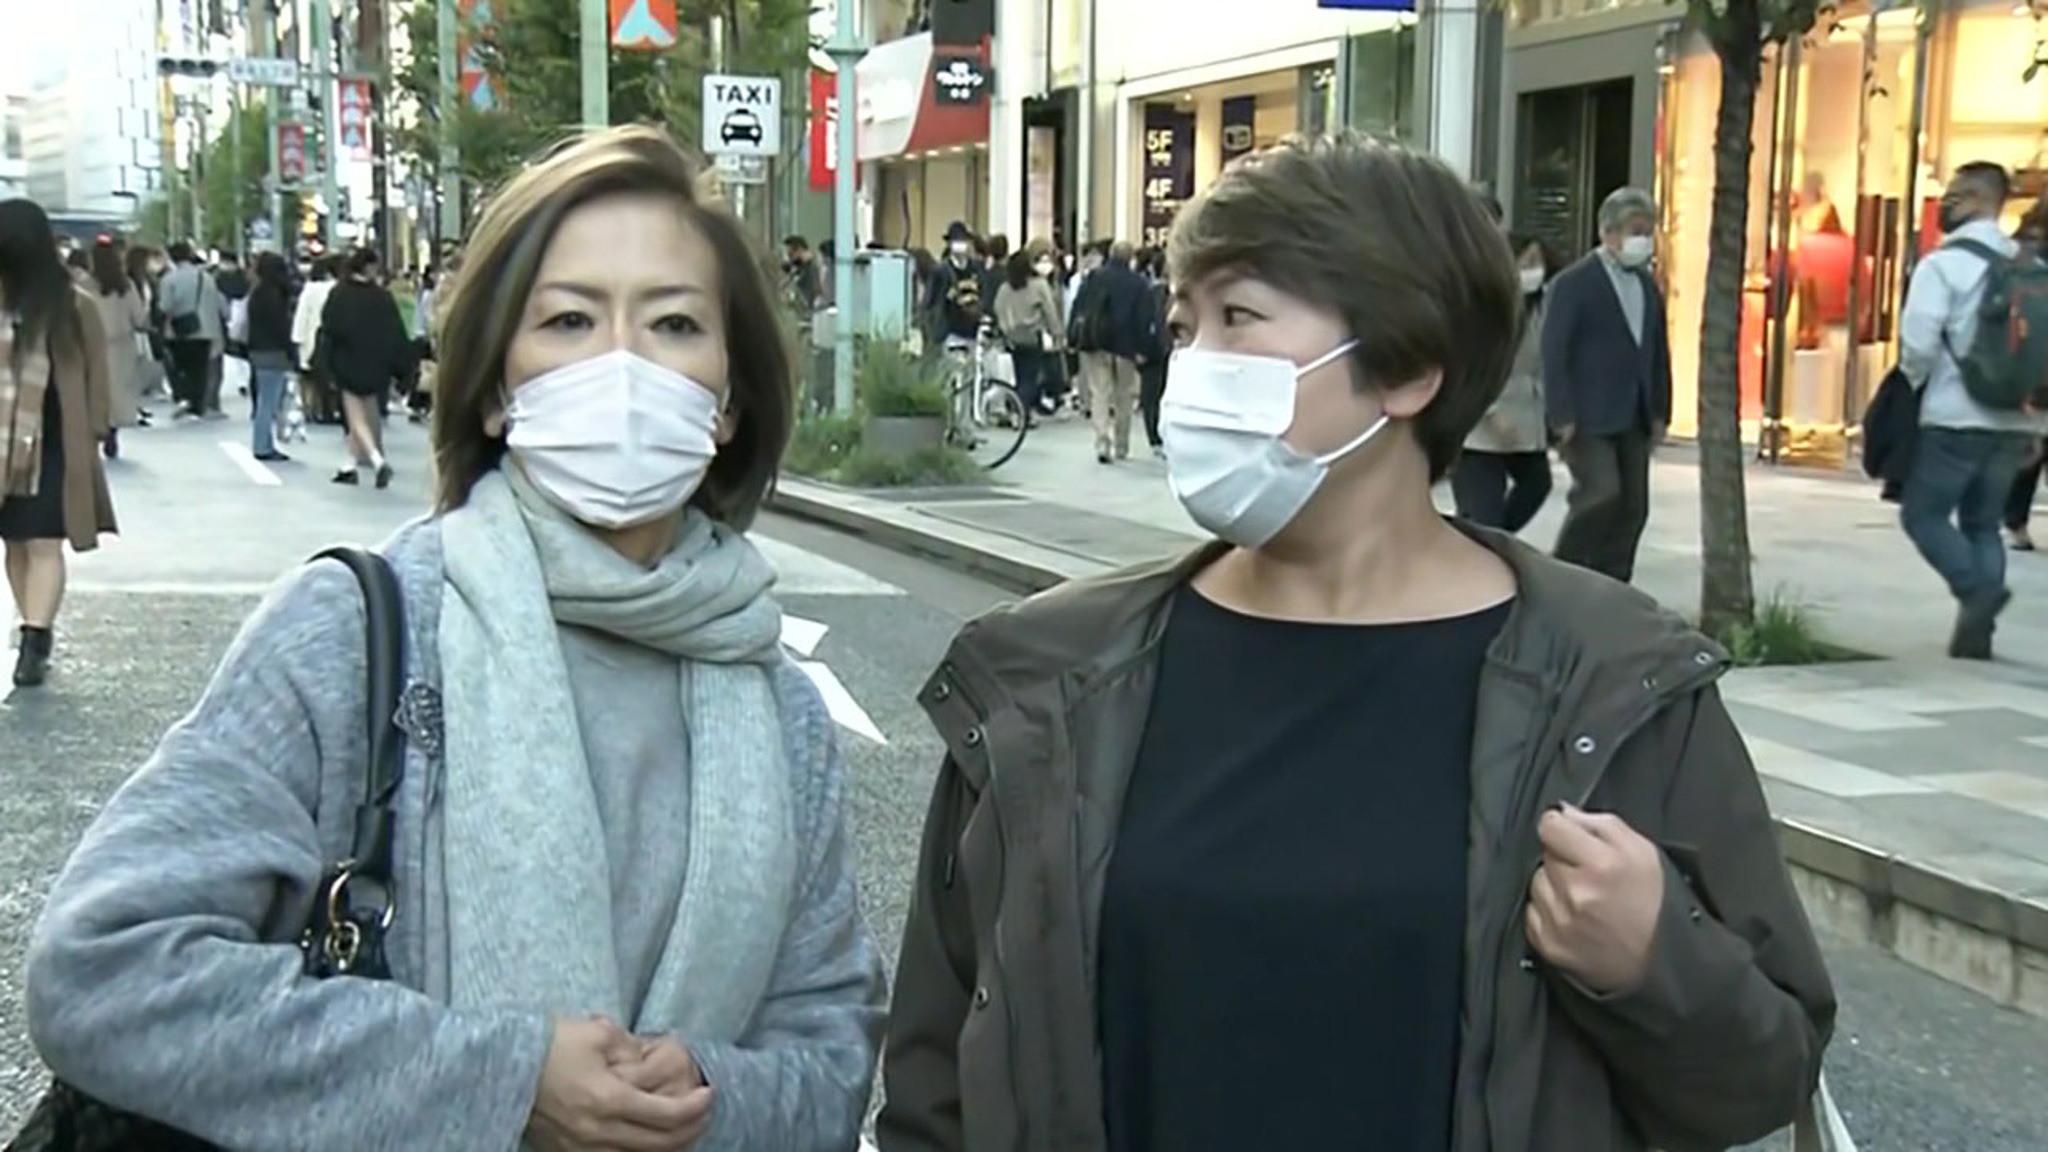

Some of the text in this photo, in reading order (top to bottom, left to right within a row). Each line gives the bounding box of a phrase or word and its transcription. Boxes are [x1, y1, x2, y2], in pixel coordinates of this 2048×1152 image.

[714, 84, 772, 104] TAXI
[1147, 130, 1173, 151] 5F
[1146, 178, 1173, 199] 4F
